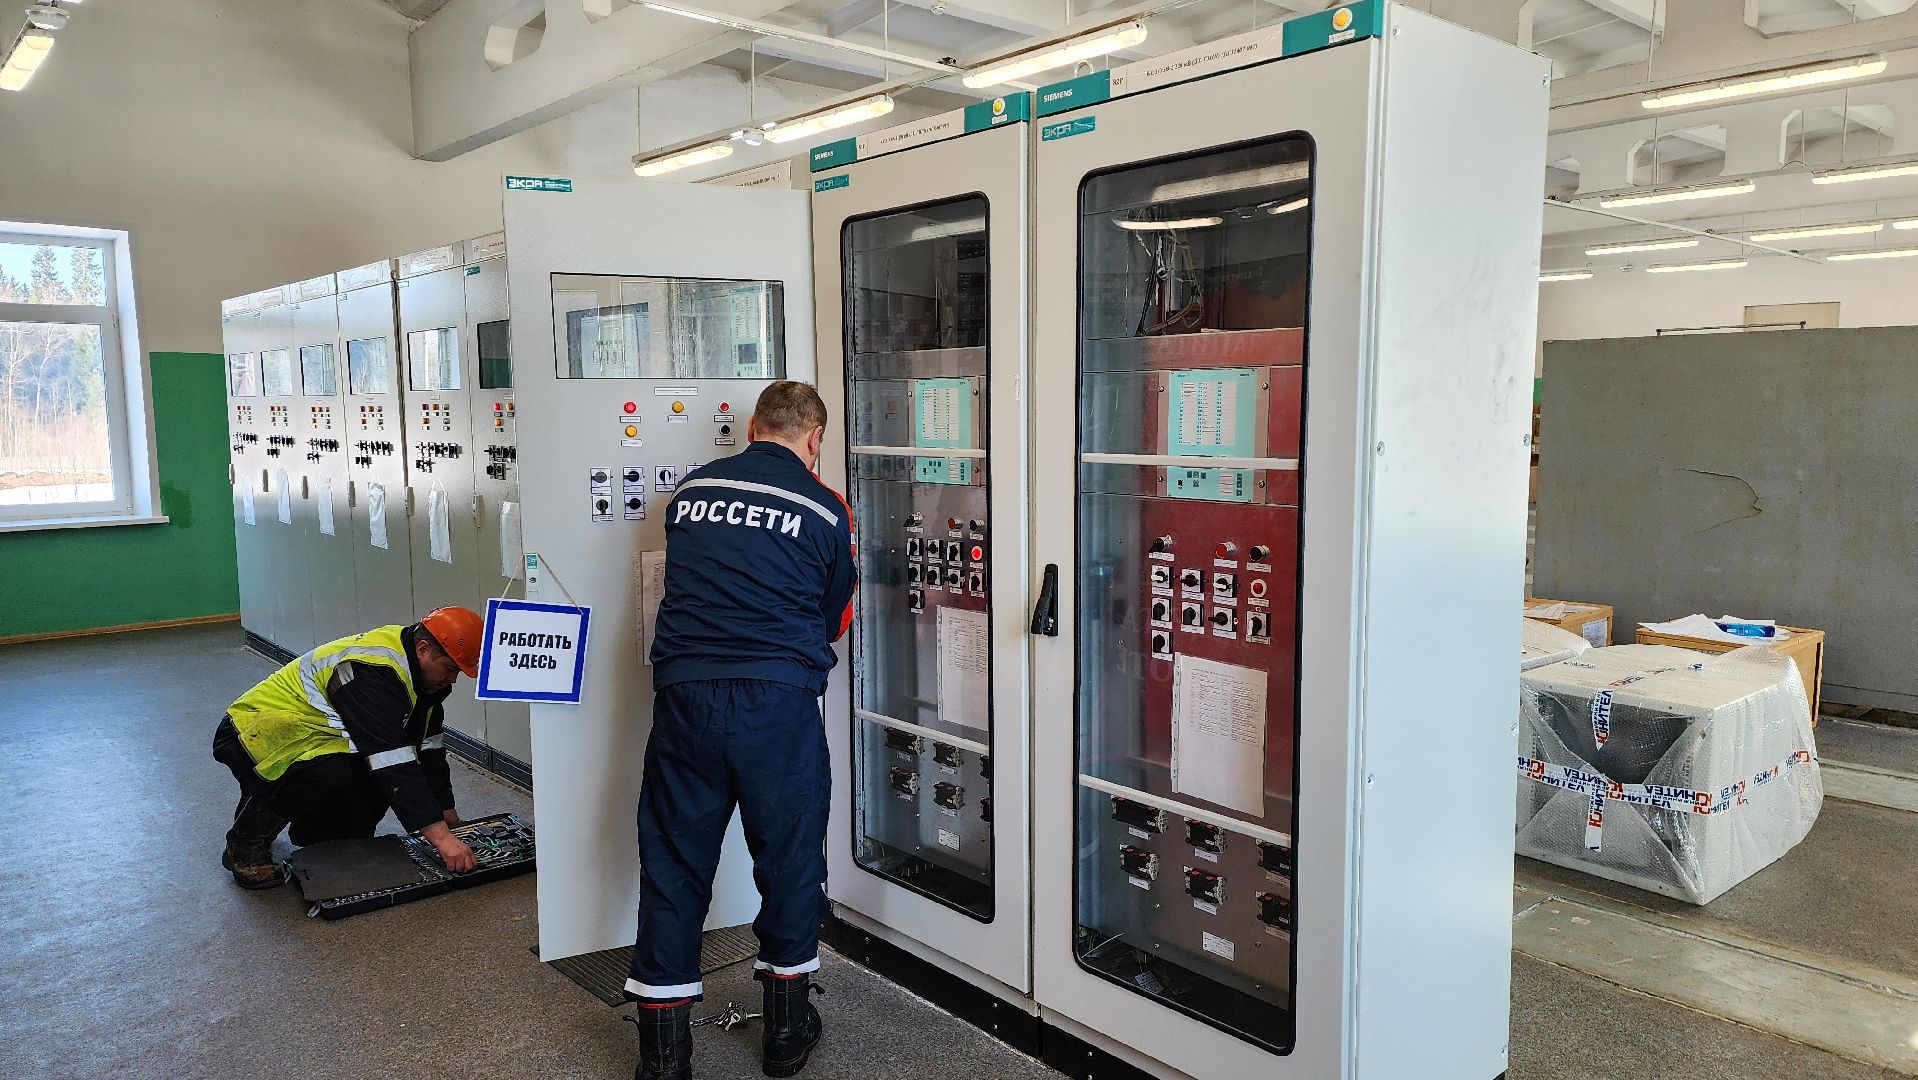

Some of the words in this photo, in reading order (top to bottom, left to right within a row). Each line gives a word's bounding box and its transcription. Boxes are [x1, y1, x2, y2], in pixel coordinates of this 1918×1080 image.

[1043, 88, 1073, 103] SIEMENS
[674, 500, 802, 538] РОССЕТИ
[499, 631, 572, 650] РАБОТАТЬ
[509, 652, 557, 669] ЗДЕСЬ
[1596, 690, 1613, 745] ЮНИТЕЛ
[1644, 785, 1713, 807] ЮНИТЕЛ
